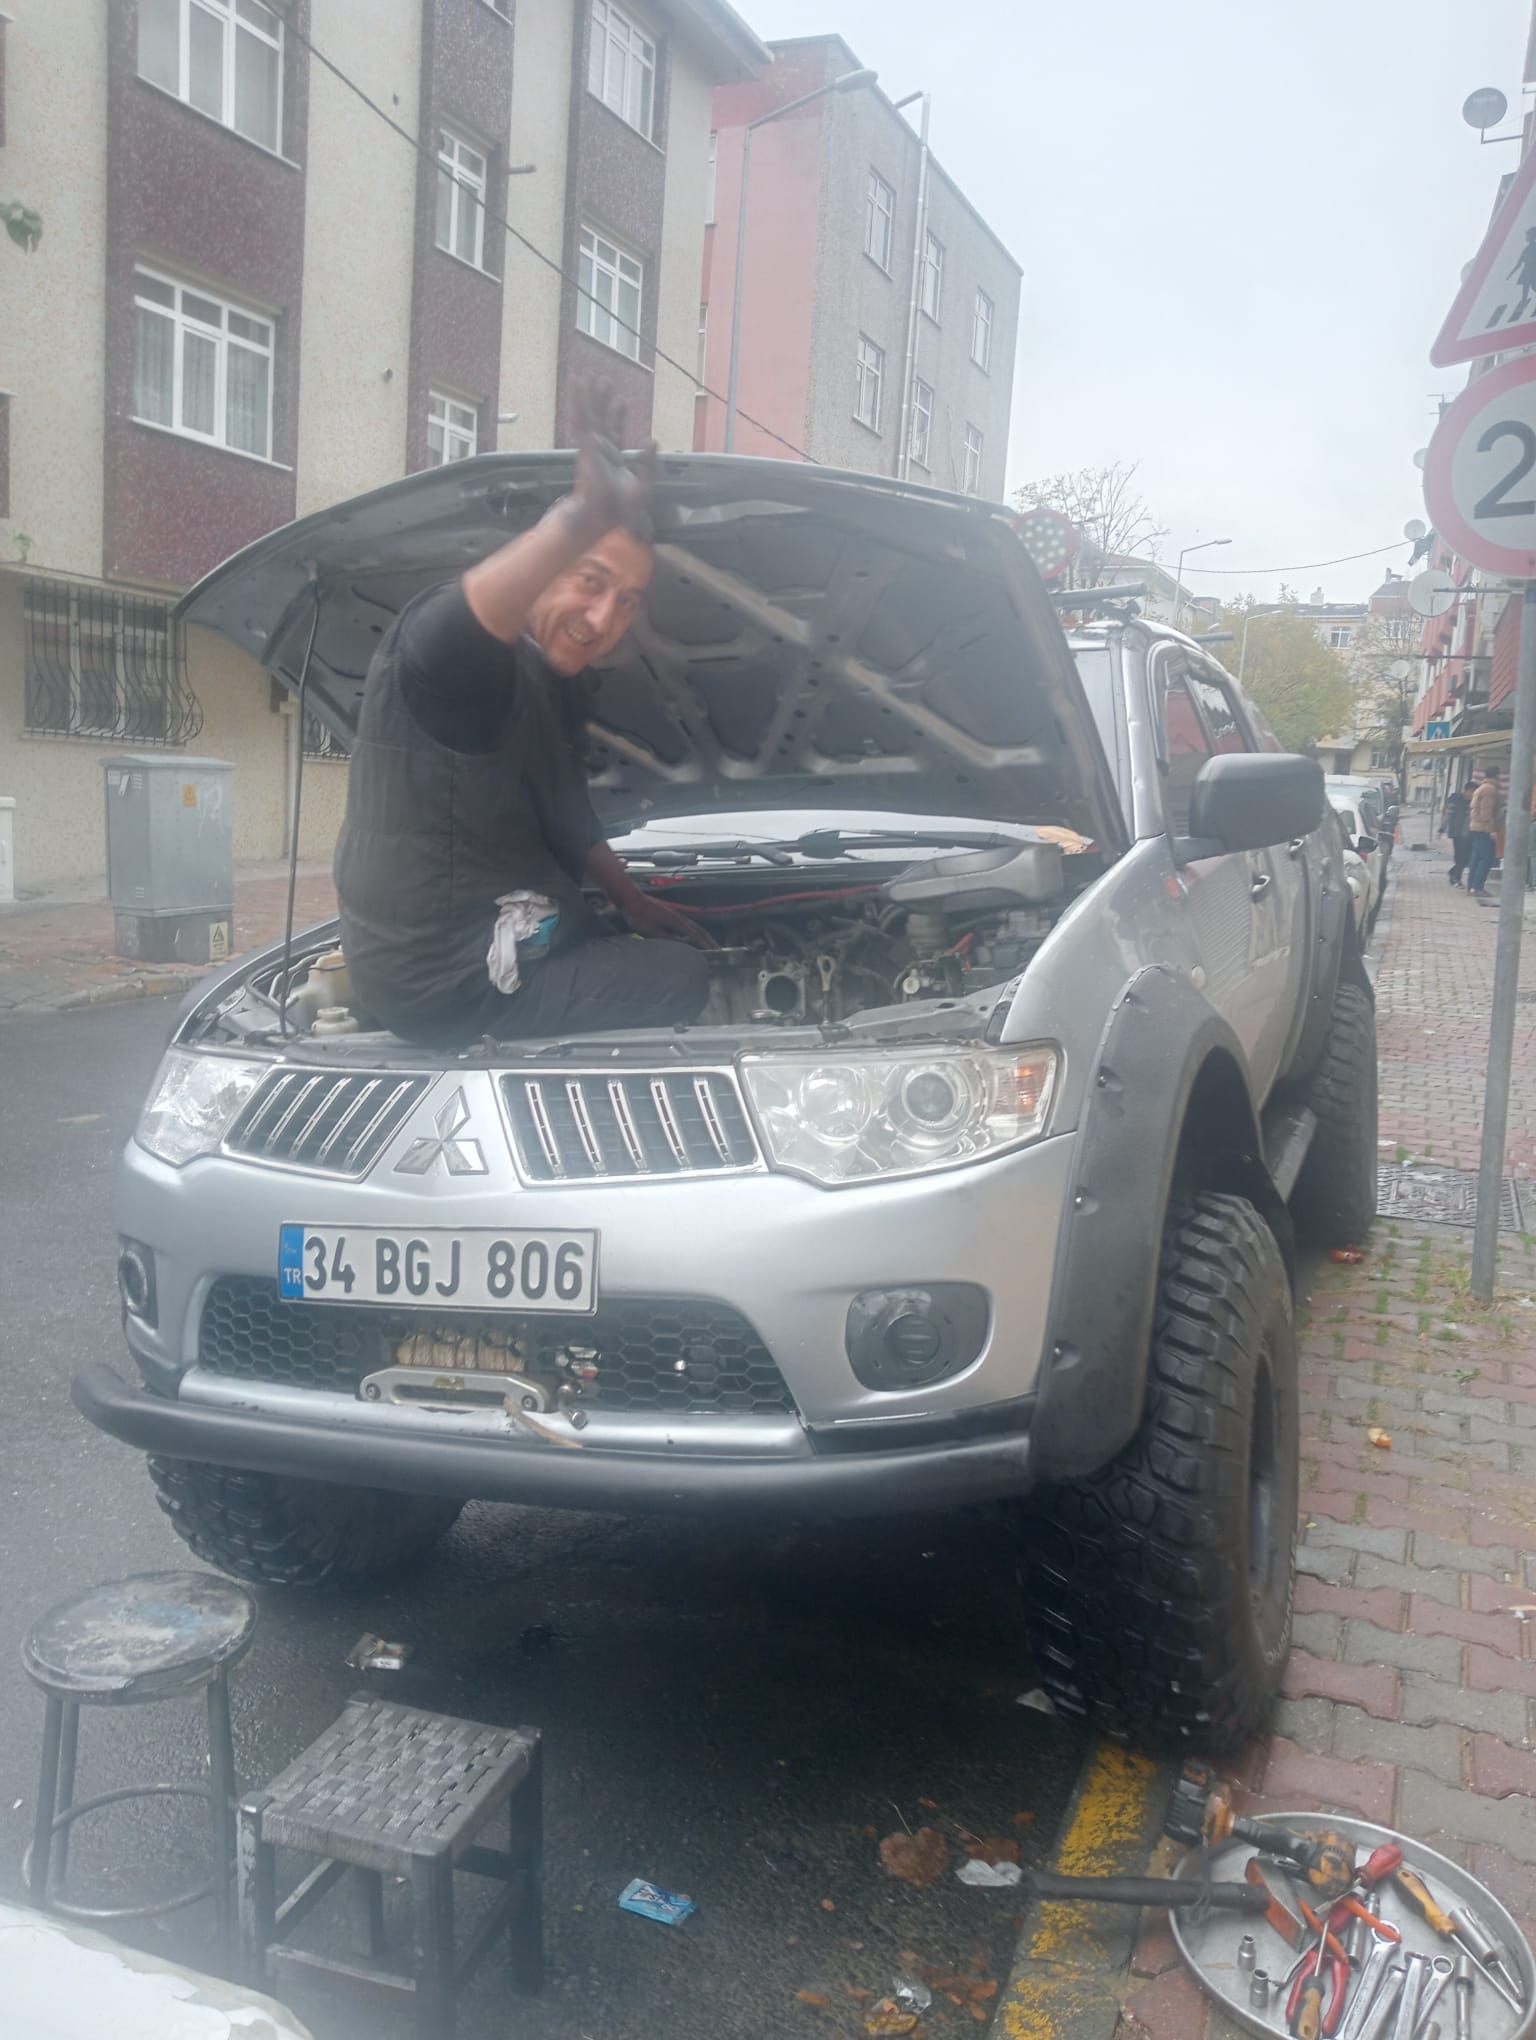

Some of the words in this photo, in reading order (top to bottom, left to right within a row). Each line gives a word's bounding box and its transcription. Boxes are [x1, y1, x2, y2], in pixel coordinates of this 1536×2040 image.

[284, 1267, 301, 1284] TR
[304, 1236, 355, 1293] 34
[376, 1238, 460, 1297] BGJ
[487, 1240, 584, 1300] 806
